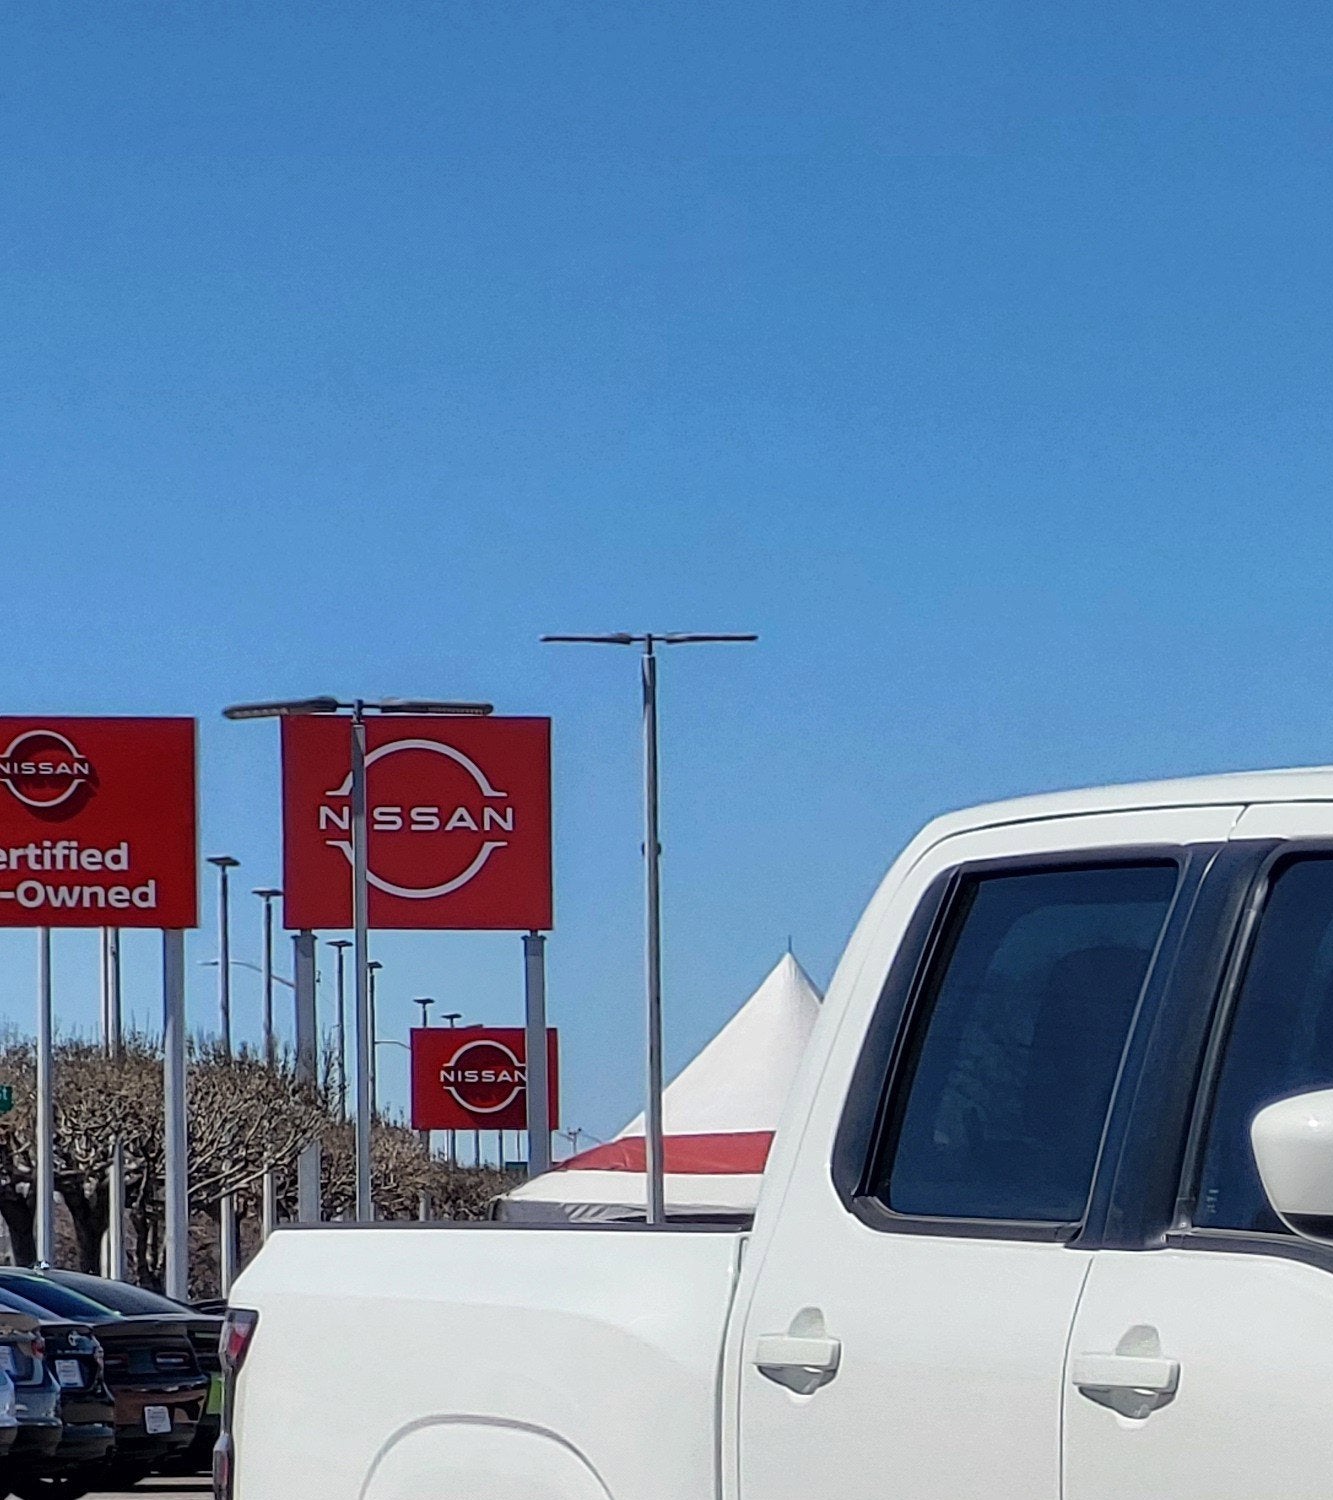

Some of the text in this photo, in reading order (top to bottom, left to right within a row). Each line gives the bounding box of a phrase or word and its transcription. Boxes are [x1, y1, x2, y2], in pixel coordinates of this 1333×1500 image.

[0, 762, 89, 775] NISSAN
[319, 805, 514, 832] NSSAN
[440, 1070, 528, 1082] NISSAN
